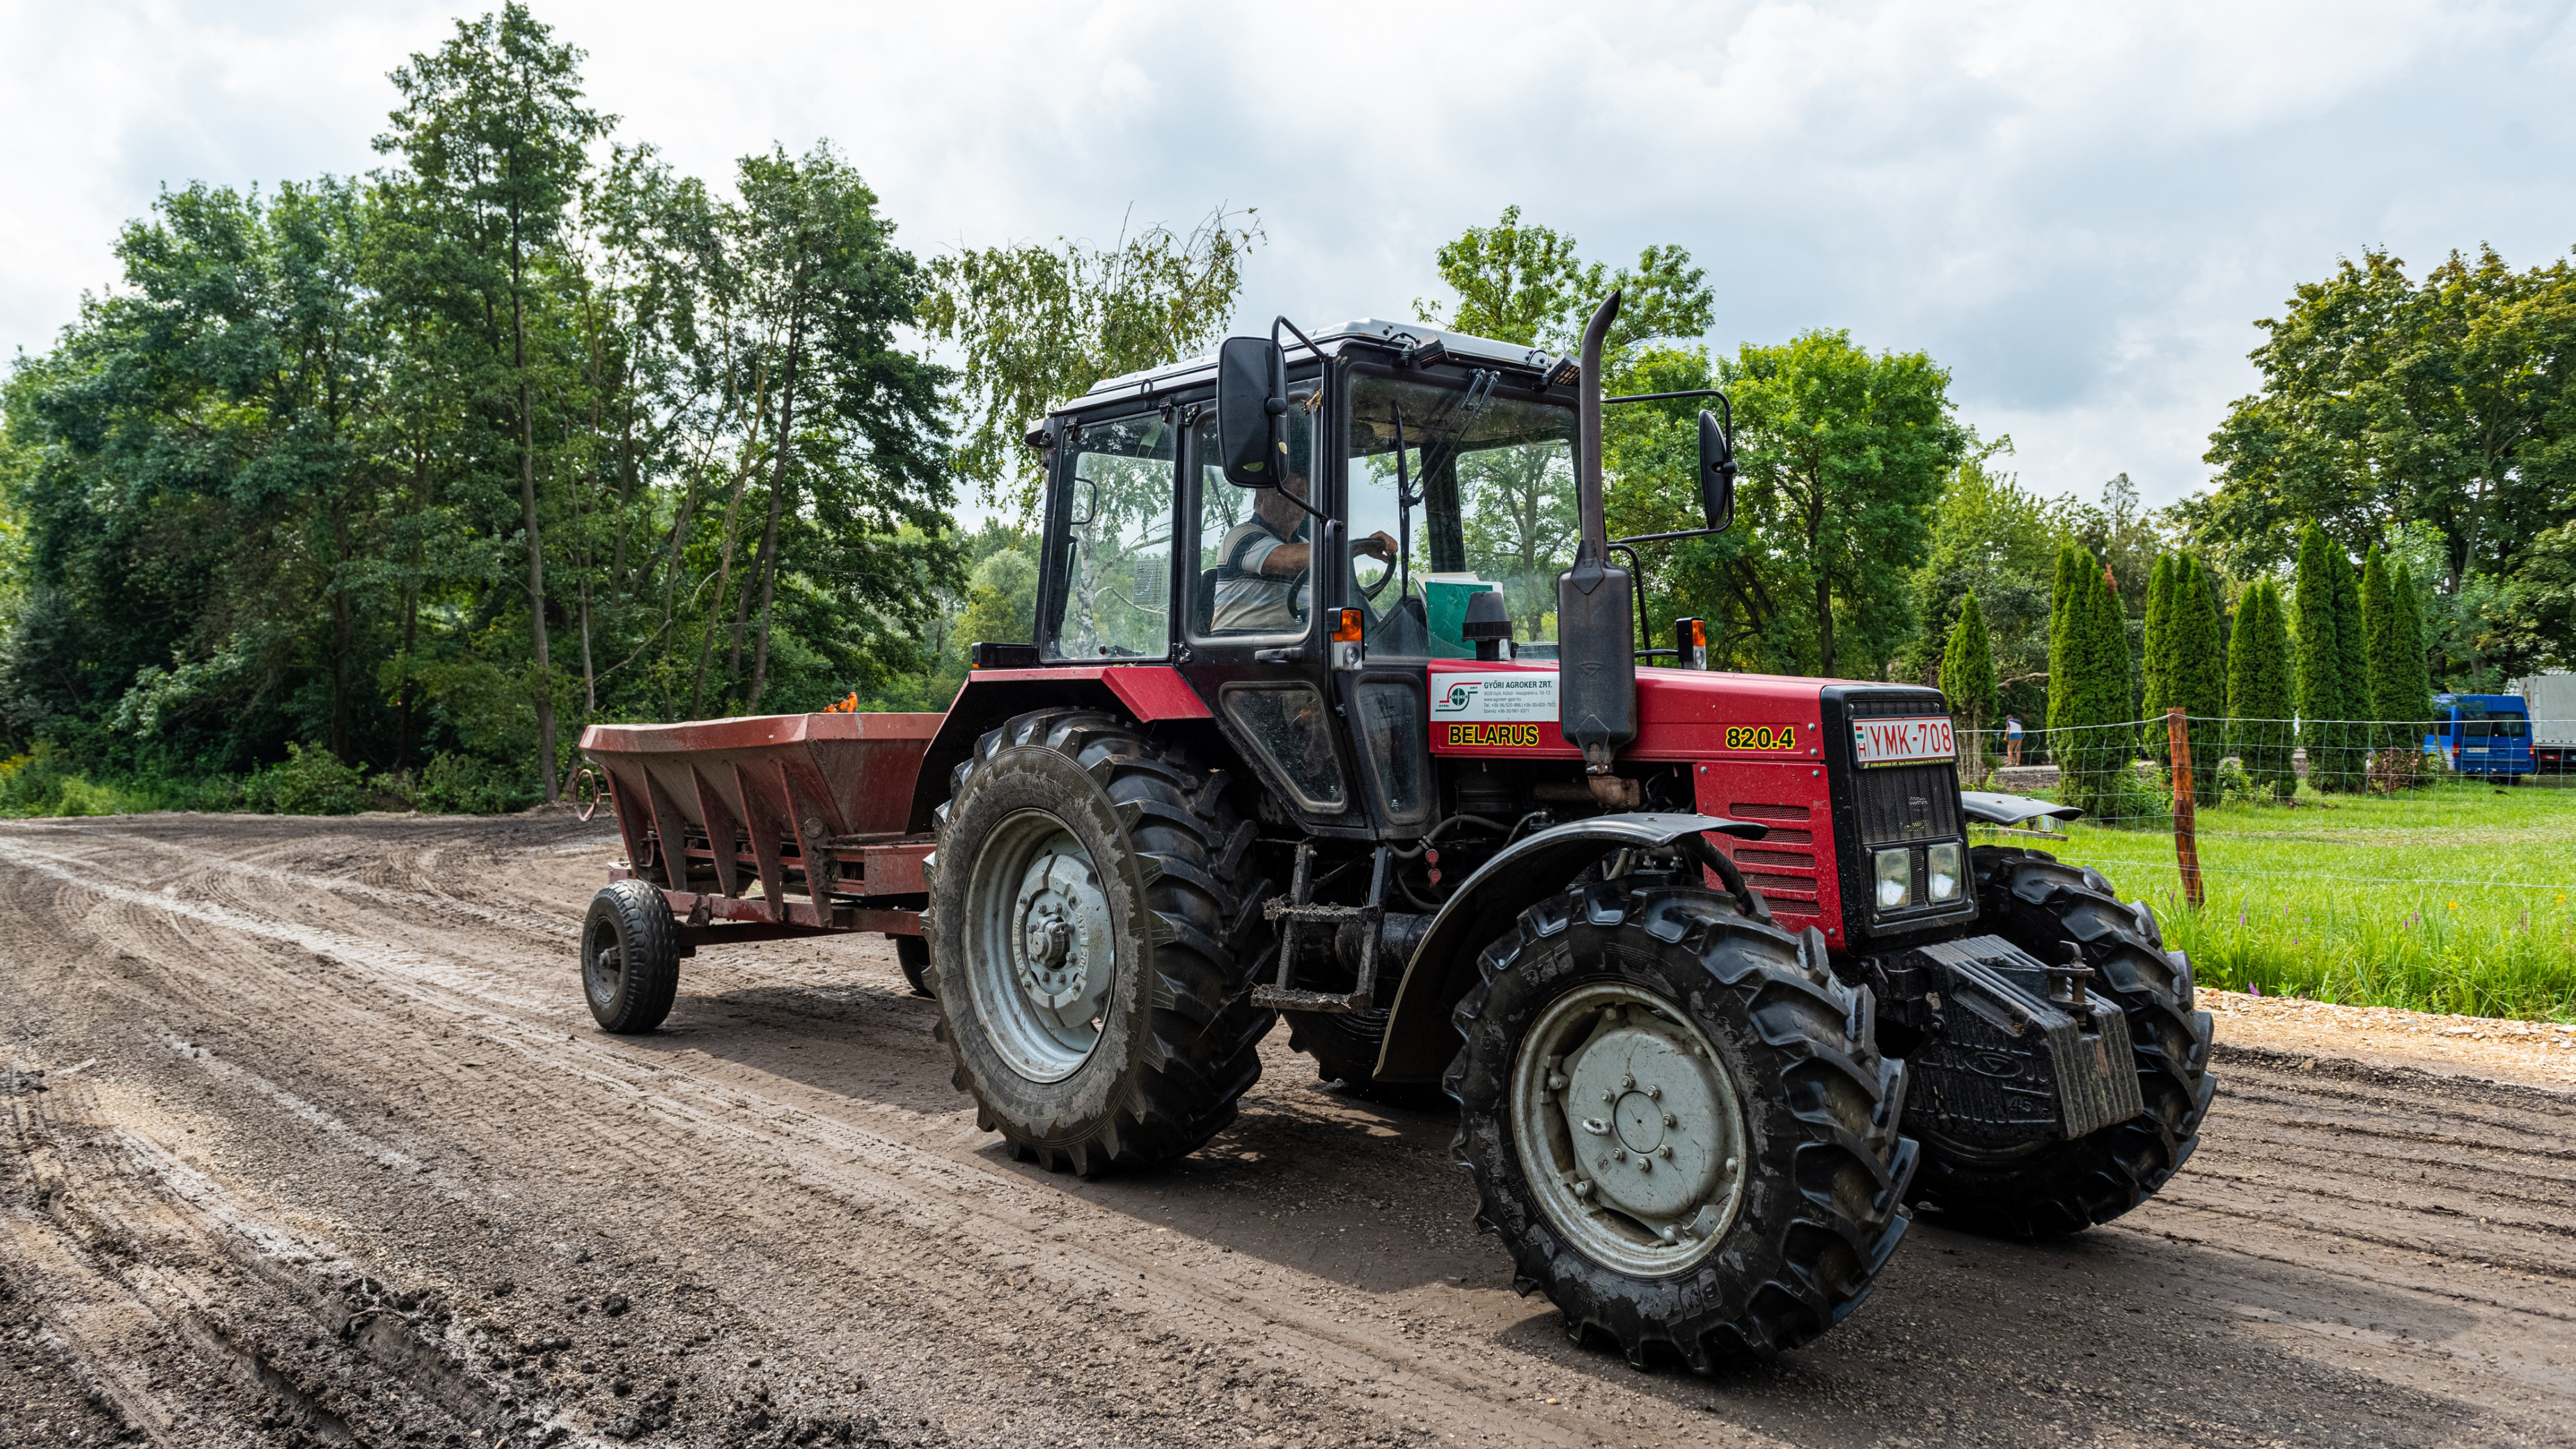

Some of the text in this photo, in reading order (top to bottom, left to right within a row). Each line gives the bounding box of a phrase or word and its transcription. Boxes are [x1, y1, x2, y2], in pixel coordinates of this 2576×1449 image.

[1484, 680, 1504, 689] GYŐRI
[1505, 680, 1537, 689] AGROKER
[1448, 724, 1539, 746] BELARUS
[1725, 726, 1796, 750] 820.4
[1857, 722, 1952, 757] H YMK-708
